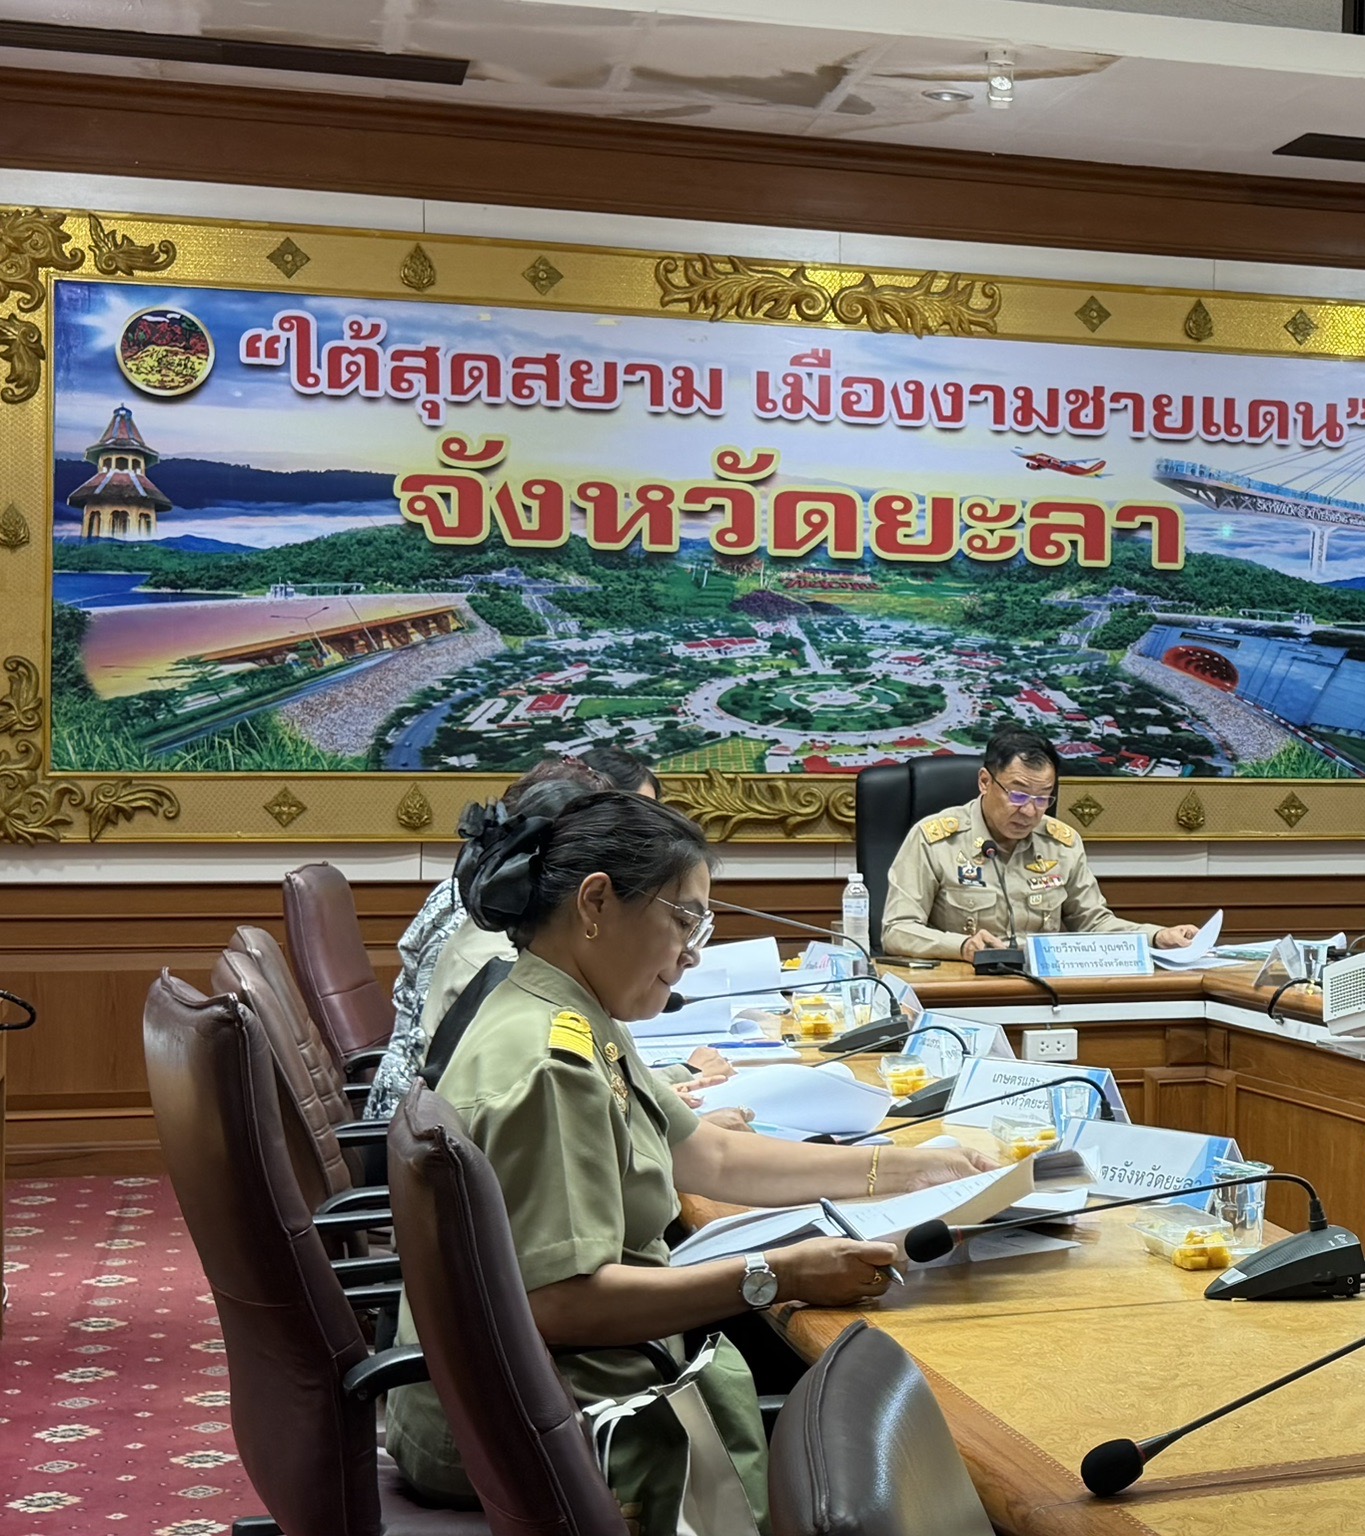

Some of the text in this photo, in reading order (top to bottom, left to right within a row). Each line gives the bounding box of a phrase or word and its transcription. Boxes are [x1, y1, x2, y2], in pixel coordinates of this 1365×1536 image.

[244, 313, 724, 421] “ใต้สุดสยาม
[398, 433, 1182, 567] จังหวัดยะลา
[1256, 500, 1295, 516] SKYWALK
